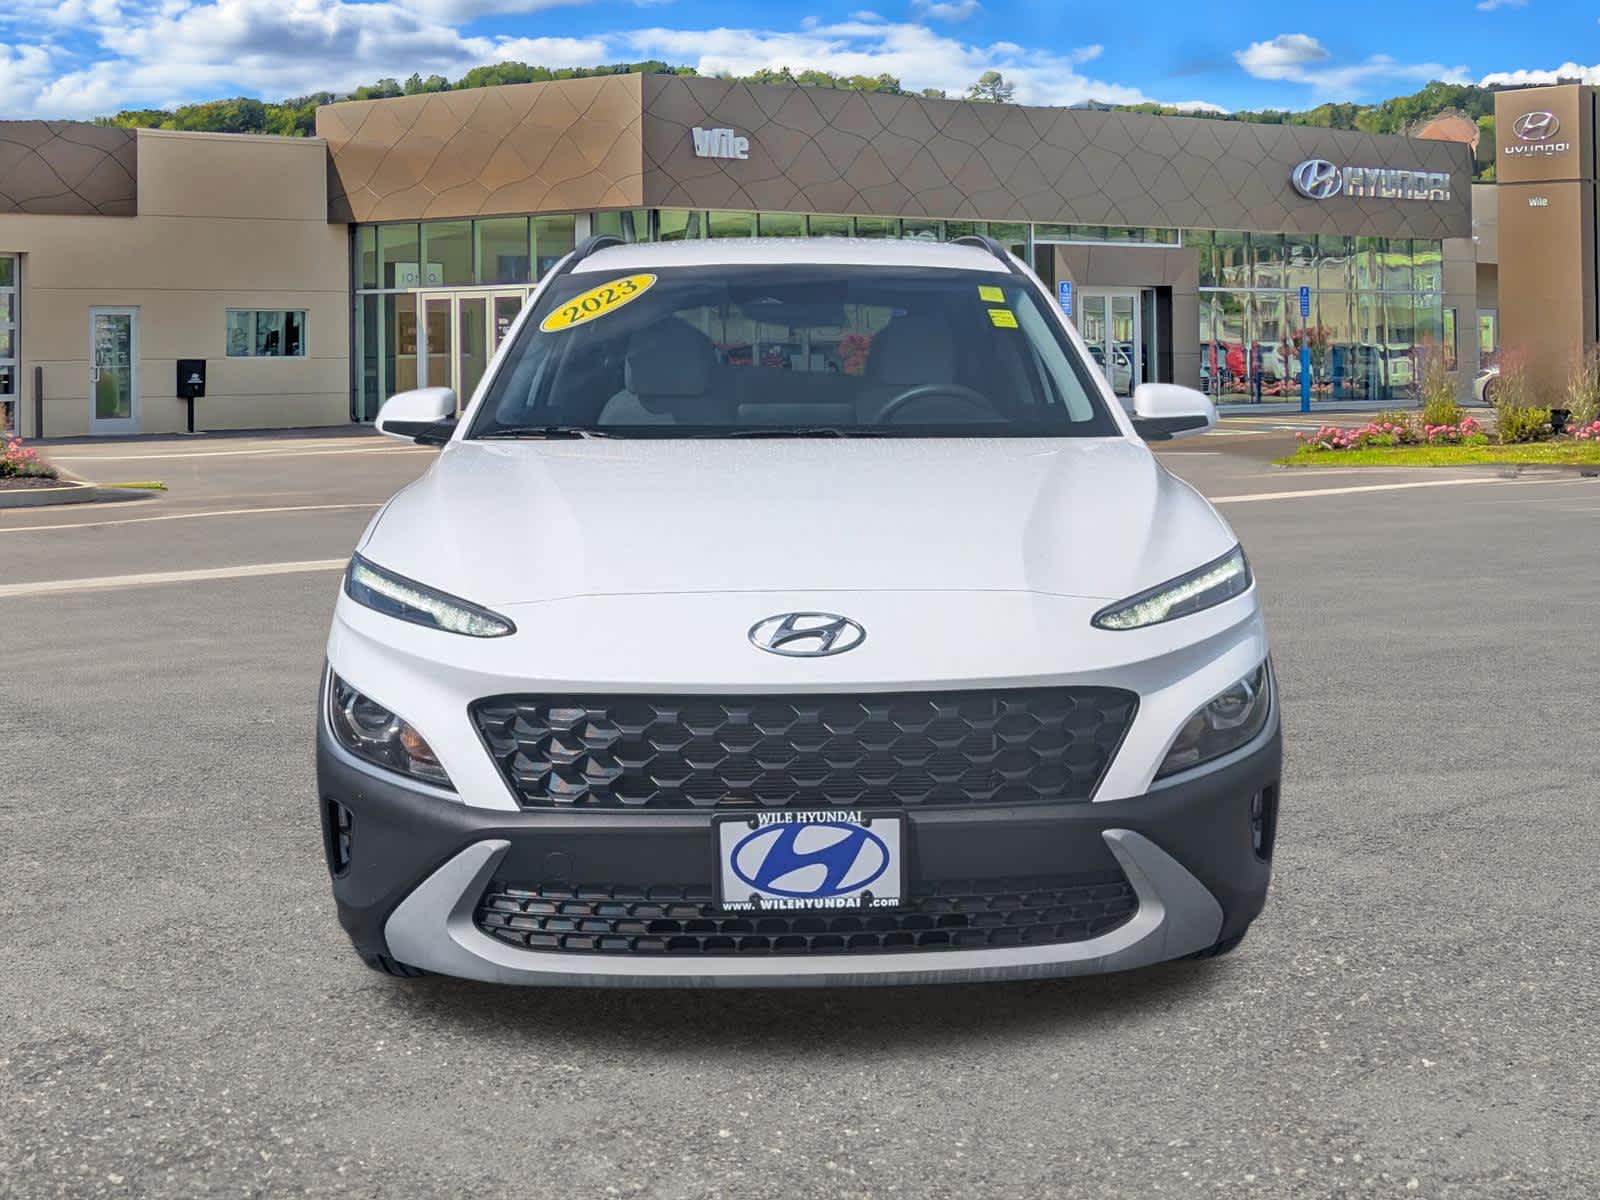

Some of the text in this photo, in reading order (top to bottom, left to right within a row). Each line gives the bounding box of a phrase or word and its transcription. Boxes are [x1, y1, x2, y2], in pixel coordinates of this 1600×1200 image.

[692, 127, 749, 159] Wile
[1342, 167, 1451, 200] HYUNDAI
[1528, 197, 1548, 207] Wile
[401, 272, 437, 282] IOQ
[563, 280, 638, 323] 2023
[757, 811, 863, 825] WILE HYUNDAI
[760, 897, 861, 910] WILEHYUNDAI
